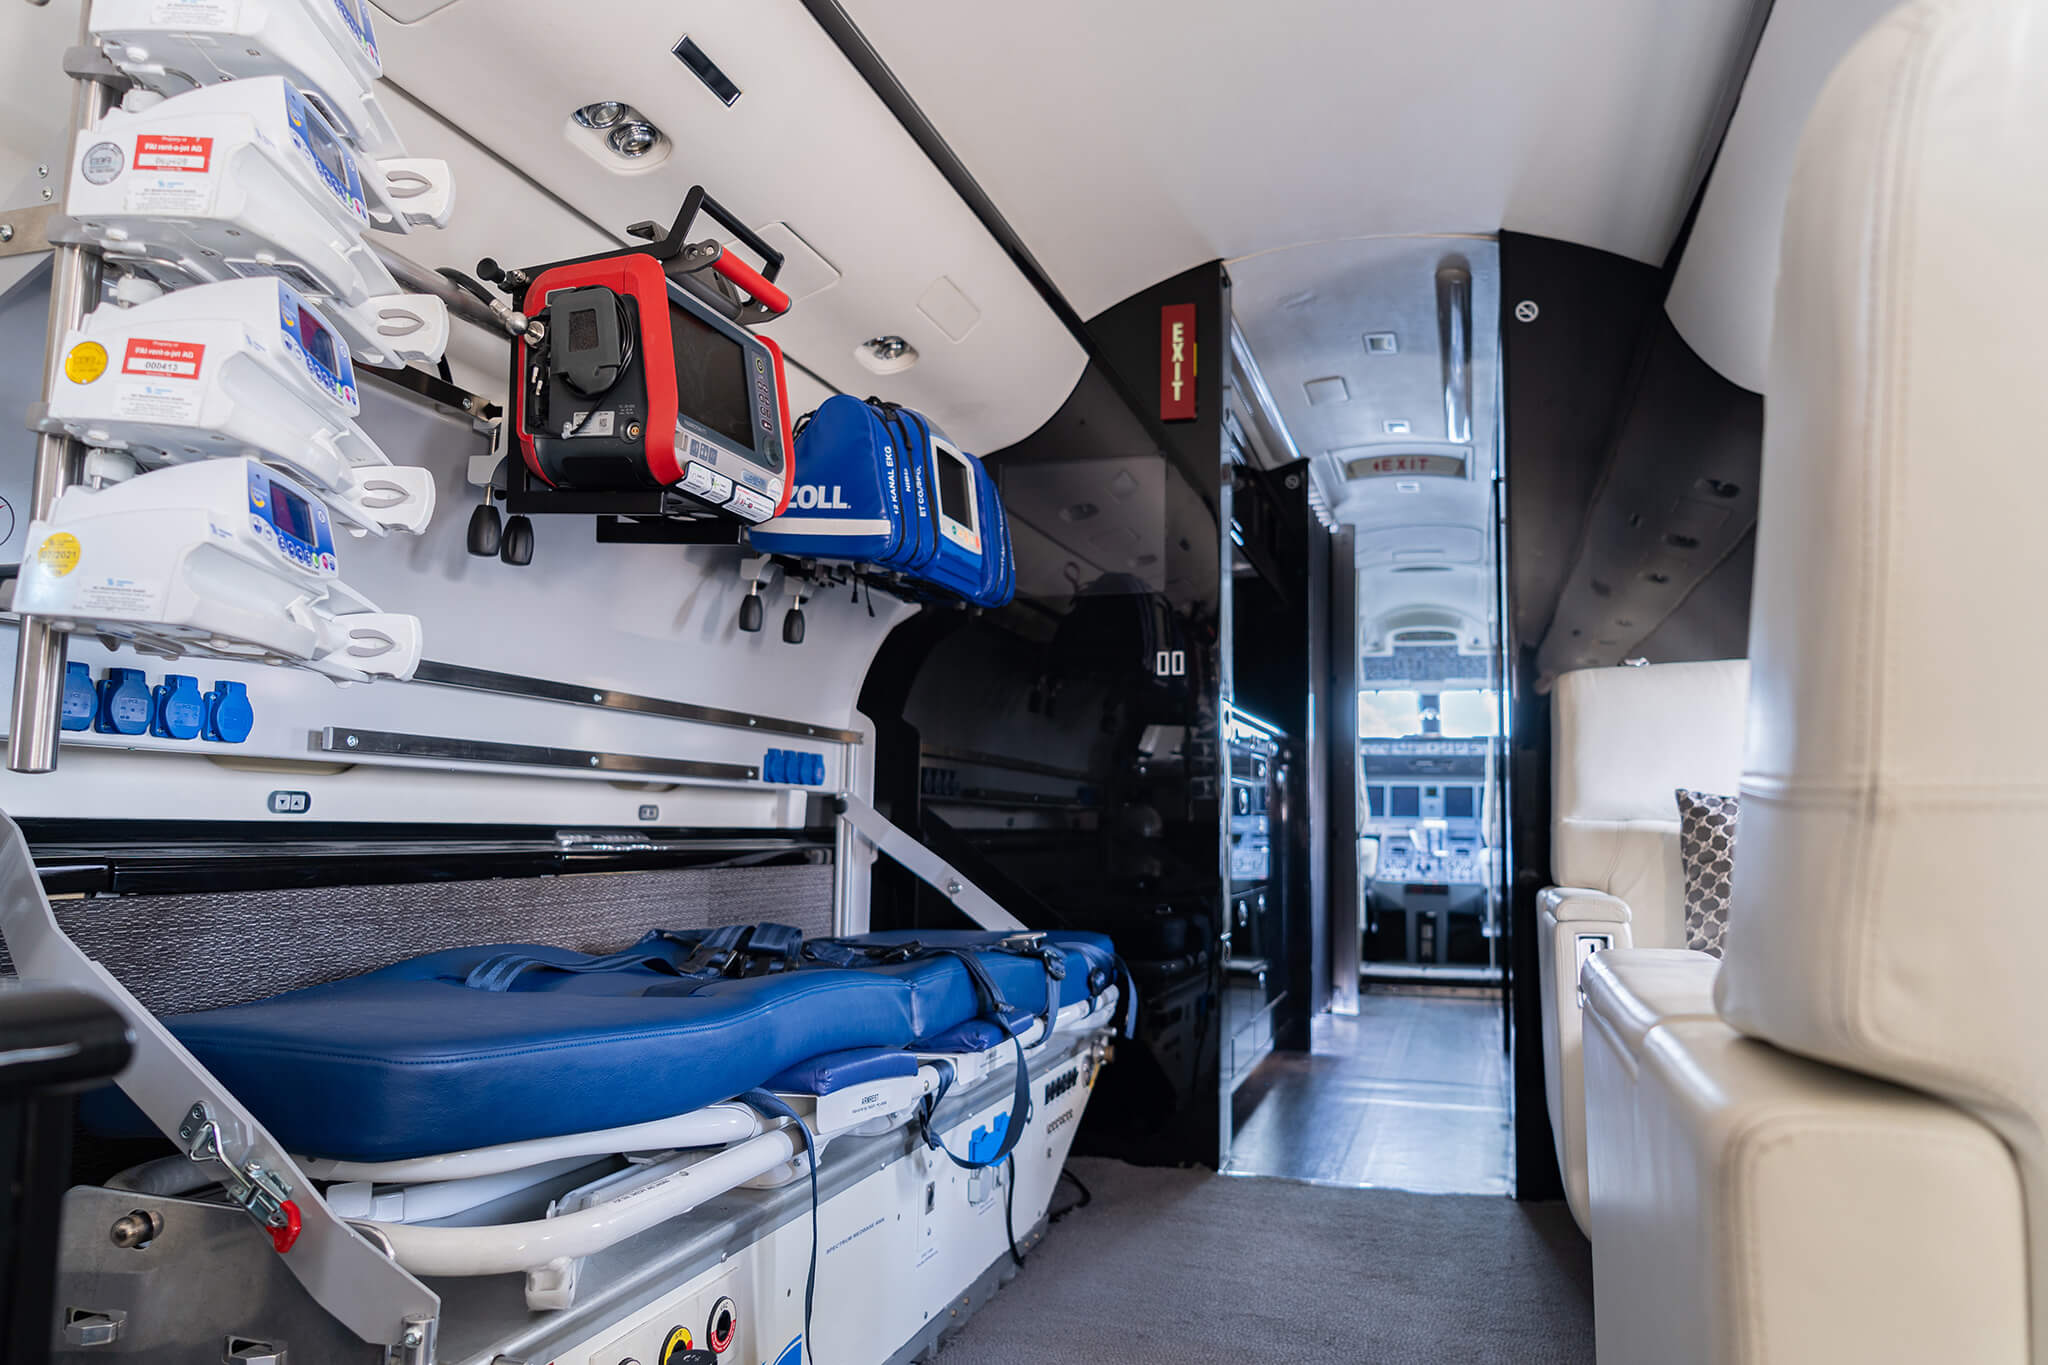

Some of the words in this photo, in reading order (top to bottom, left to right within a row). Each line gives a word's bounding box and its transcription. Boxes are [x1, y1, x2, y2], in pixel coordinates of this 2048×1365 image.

[1171, 322, 1185, 401] EXIT
[883, 445, 895, 467] EKG
[1381, 457, 1429, 471] EXIT
[887, 469, 898, 503] KANAL
